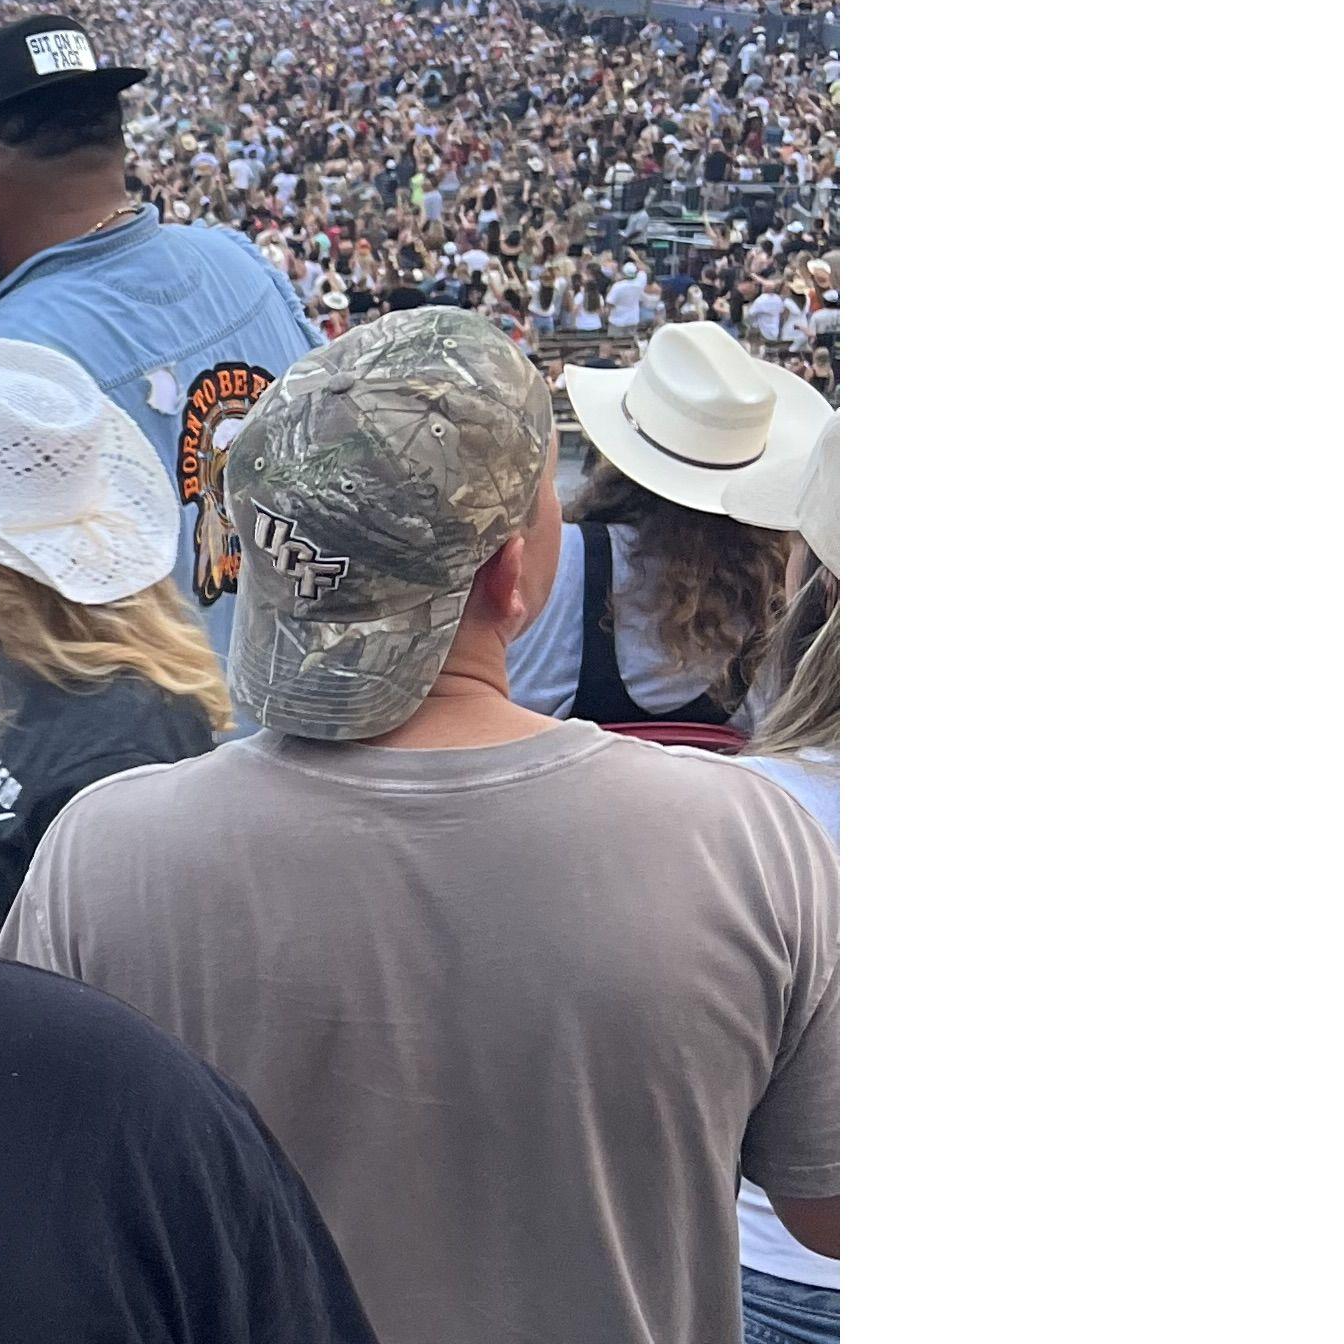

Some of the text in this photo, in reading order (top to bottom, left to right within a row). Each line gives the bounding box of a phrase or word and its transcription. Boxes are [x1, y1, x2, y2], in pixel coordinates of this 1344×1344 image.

[30, 35, 52, 55] SIT
[53, 33, 72, 51] ON
[52, 50, 83, 69] FACE
[192, 378, 217, 414] TO
[217, 368, 248, 398] BE
[182, 409, 204, 499] BORN
[253, 506, 345, 599] UCF
